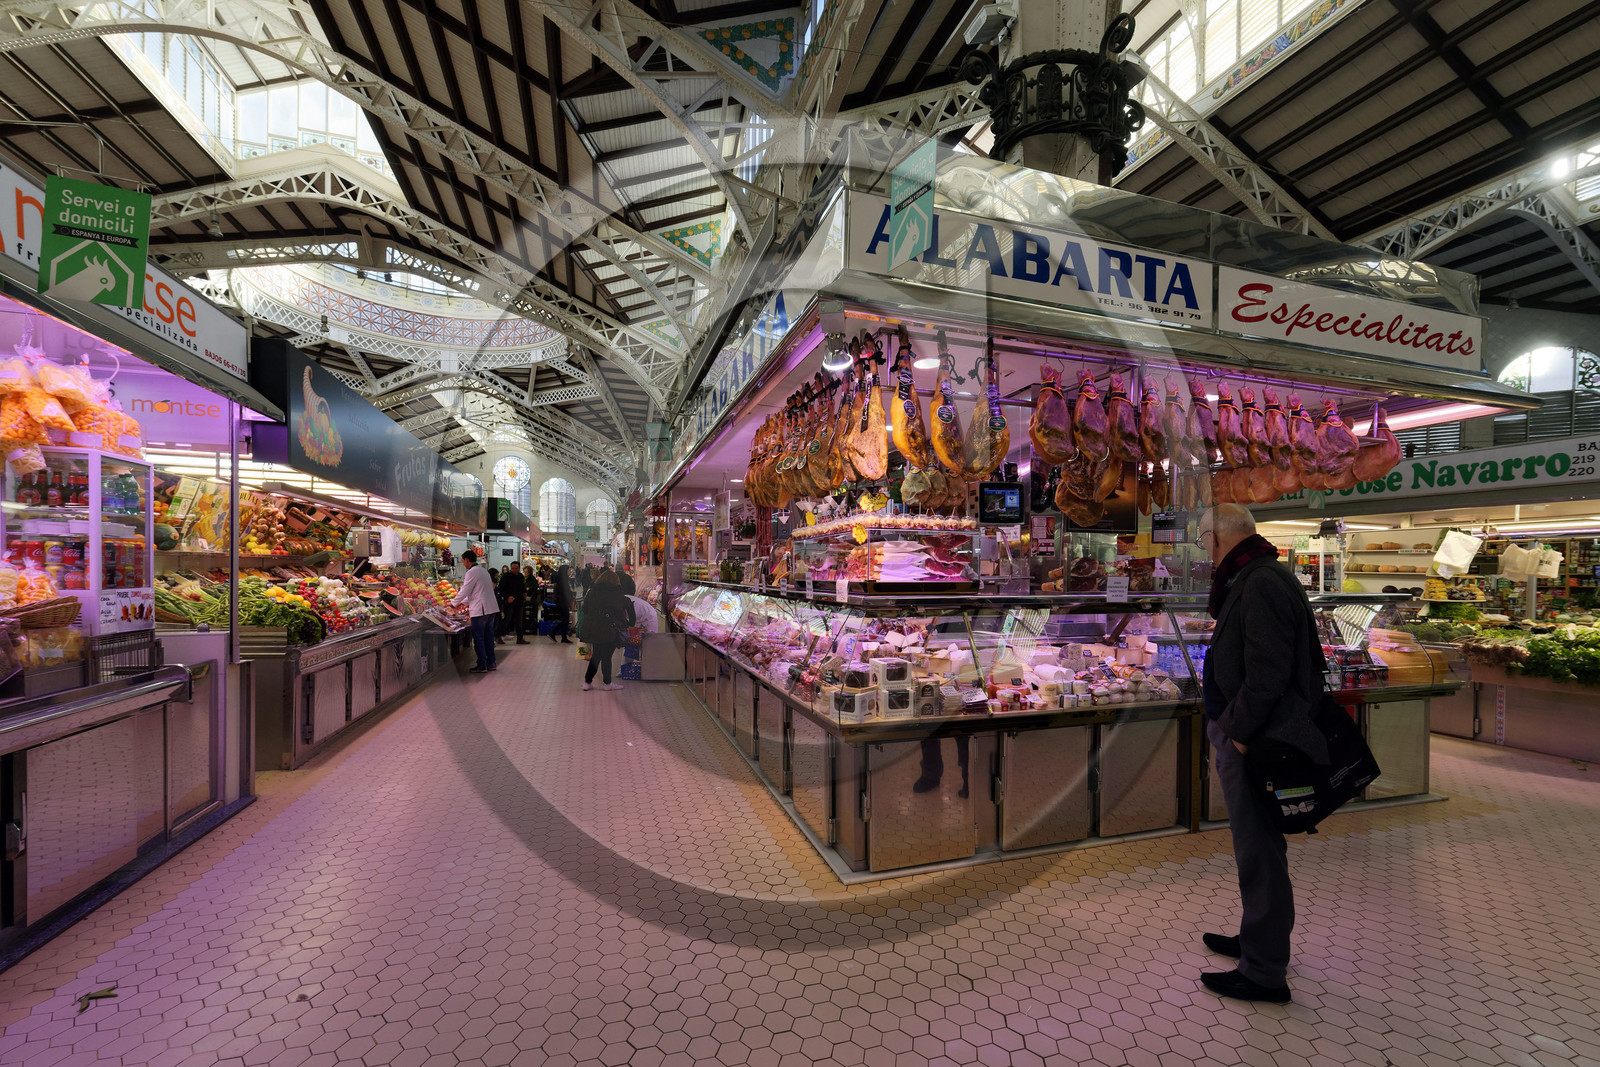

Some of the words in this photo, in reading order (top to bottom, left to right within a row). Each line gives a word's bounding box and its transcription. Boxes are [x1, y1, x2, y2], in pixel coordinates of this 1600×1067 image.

[894, 158, 927, 191] Servicio
[928, 152, 934, 164] a
[894, 170, 933, 206] domicilio
[61, 189, 120, 214] Servei
[125, 205, 135, 216] a
[59, 208, 135, 234] domicili
[71, 229, 100, 240] ESPANYA
[106, 235, 132, 245] EUROPA
[1097, 297, 1123, 307] TEL.:
[1128, 302, 1143, 311] 96
[1147, 305, 1169, 315] 382
[1172, 310, 1184, 318] 91
[1188, 312, 1201, 320] 79
[1231, 283, 1475, 355] Especialitats
[118, 303, 198, 352] pecializada
[204, 348, 223, 365] BAJOS
[696, 290, 789, 440] ALABARTA
[1572, 454, 1596, 465] 219
[1577, 441, 1600, 452] BA
[394, 449, 426, 496] Frutas
[1411, 451, 1571, 490] Navarro
[1568, 466, 1595, 477] 220
